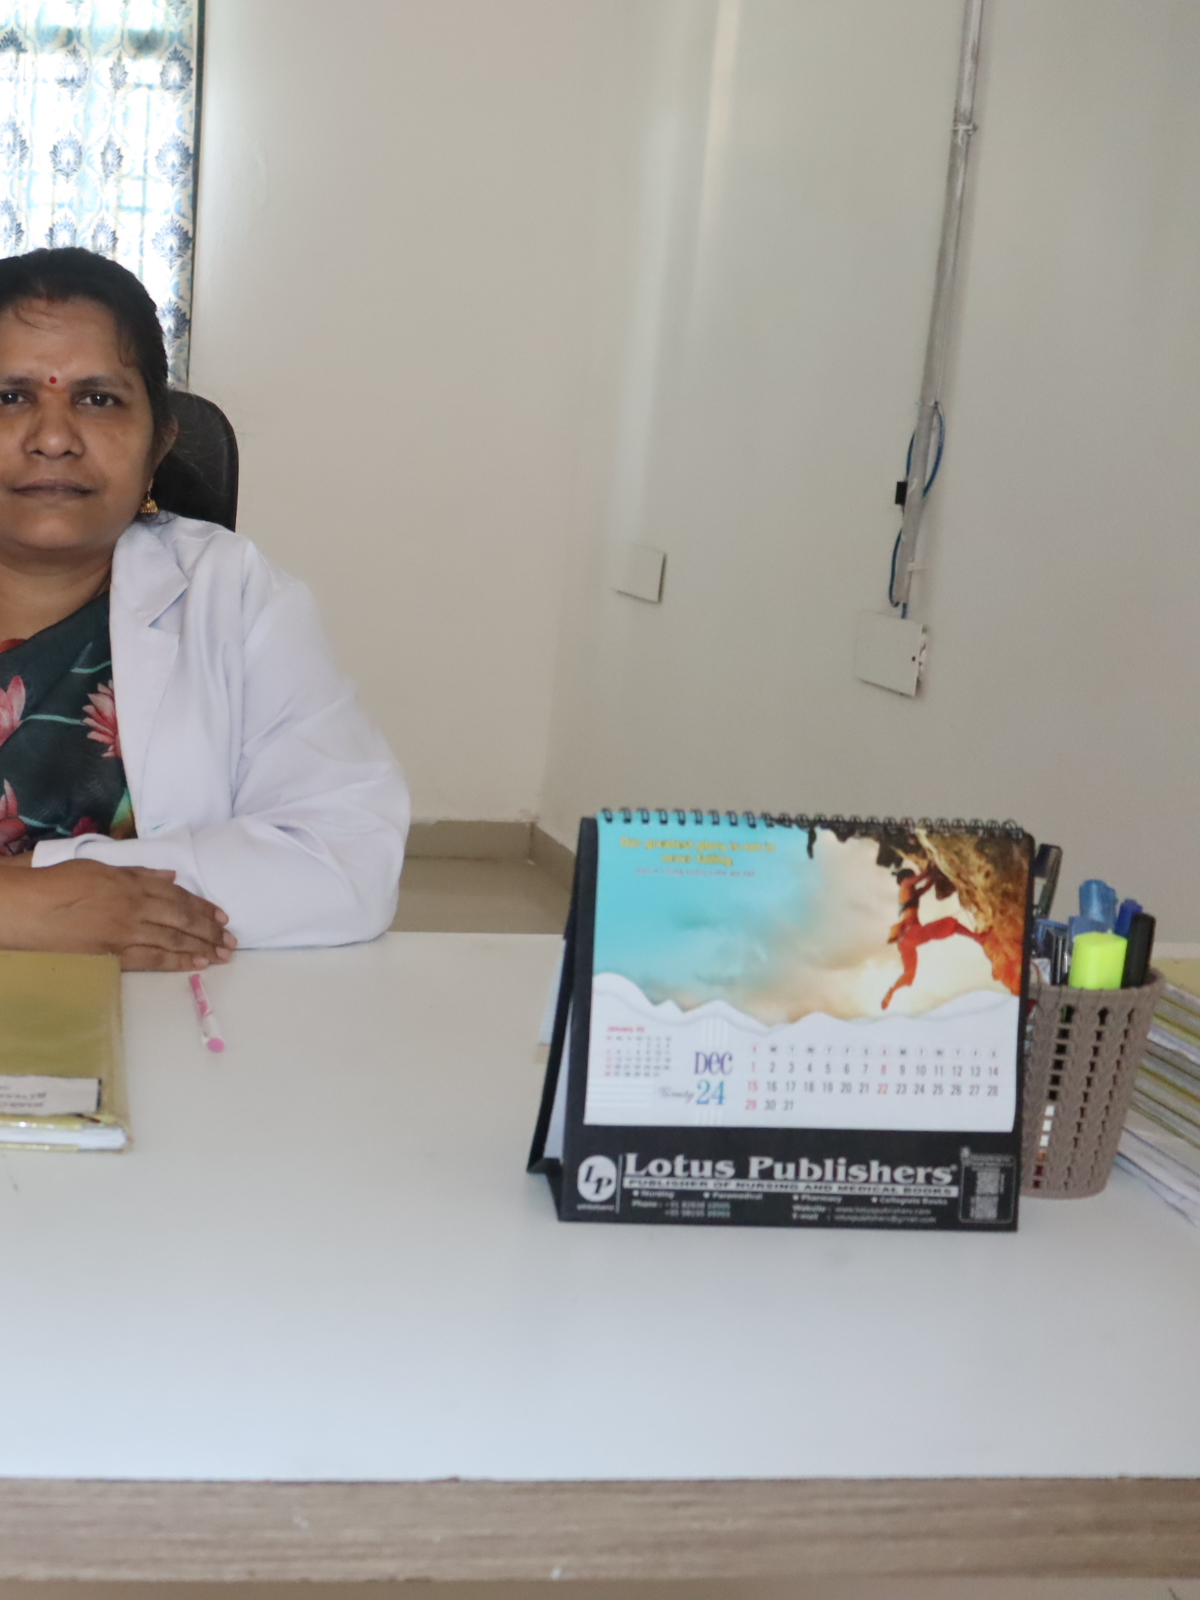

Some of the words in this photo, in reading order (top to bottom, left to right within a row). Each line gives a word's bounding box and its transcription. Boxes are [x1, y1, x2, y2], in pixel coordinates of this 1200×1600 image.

[751, 1061, 756, 1072] 1
[769, 1061, 776, 1073] 2
[788, 1061, 794, 1074] 3
[807, 1063, 812, 1073] 4
[825, 1062, 831, 1074] 5
[843, 1063, 850, 1075] 6
[863, 1063, 868, 1074] 7
[881, 1064, 887, 1075] 8
[899, 1064, 905, 1076] 9
[916, 1064, 926, 1076] 10
[934, 1064, 944, 1076] 11
[952, 1065, 963, 1077] 12
[970, 1065, 981, 1078] 13
[988, 1067, 998, 1076] 14
[696, 1079, 725, 1106] 24
[748, 1080, 759, 1092] 15
[767, 1081, 777, 1092] 16
[785, 1080, 796, 1092] 17
[804, 1081, 814, 1093] 18
[823, 1082, 833, 1093] 19
[840, 1082, 852, 1094] 20
[859, 1082, 869, 1094] 21
[877, 1083, 889, 1095] 22
[896, 1083, 907, 1095] 23
[914, 1083, 925, 1095] 24
[932, 1083, 944, 1095] 25
[950, 1084, 962, 1096] 26
[969, 1084, 980, 1096] 27
[987, 1084, 998, 1097] 28
[624, 1152, 736, 1179] Lotus
[748, 1155, 953, 1185] Publishers
[629, 1179, 709, 1188] PUBLISHER
[713, 1181, 731, 1189] OF
[735, 1182, 799, 1192] NURSING
[804, 1184, 833, 1192] AND
[837, 1185, 898, 1194] MEDICAL
[902, 1187, 952, 1195] BOOKS
